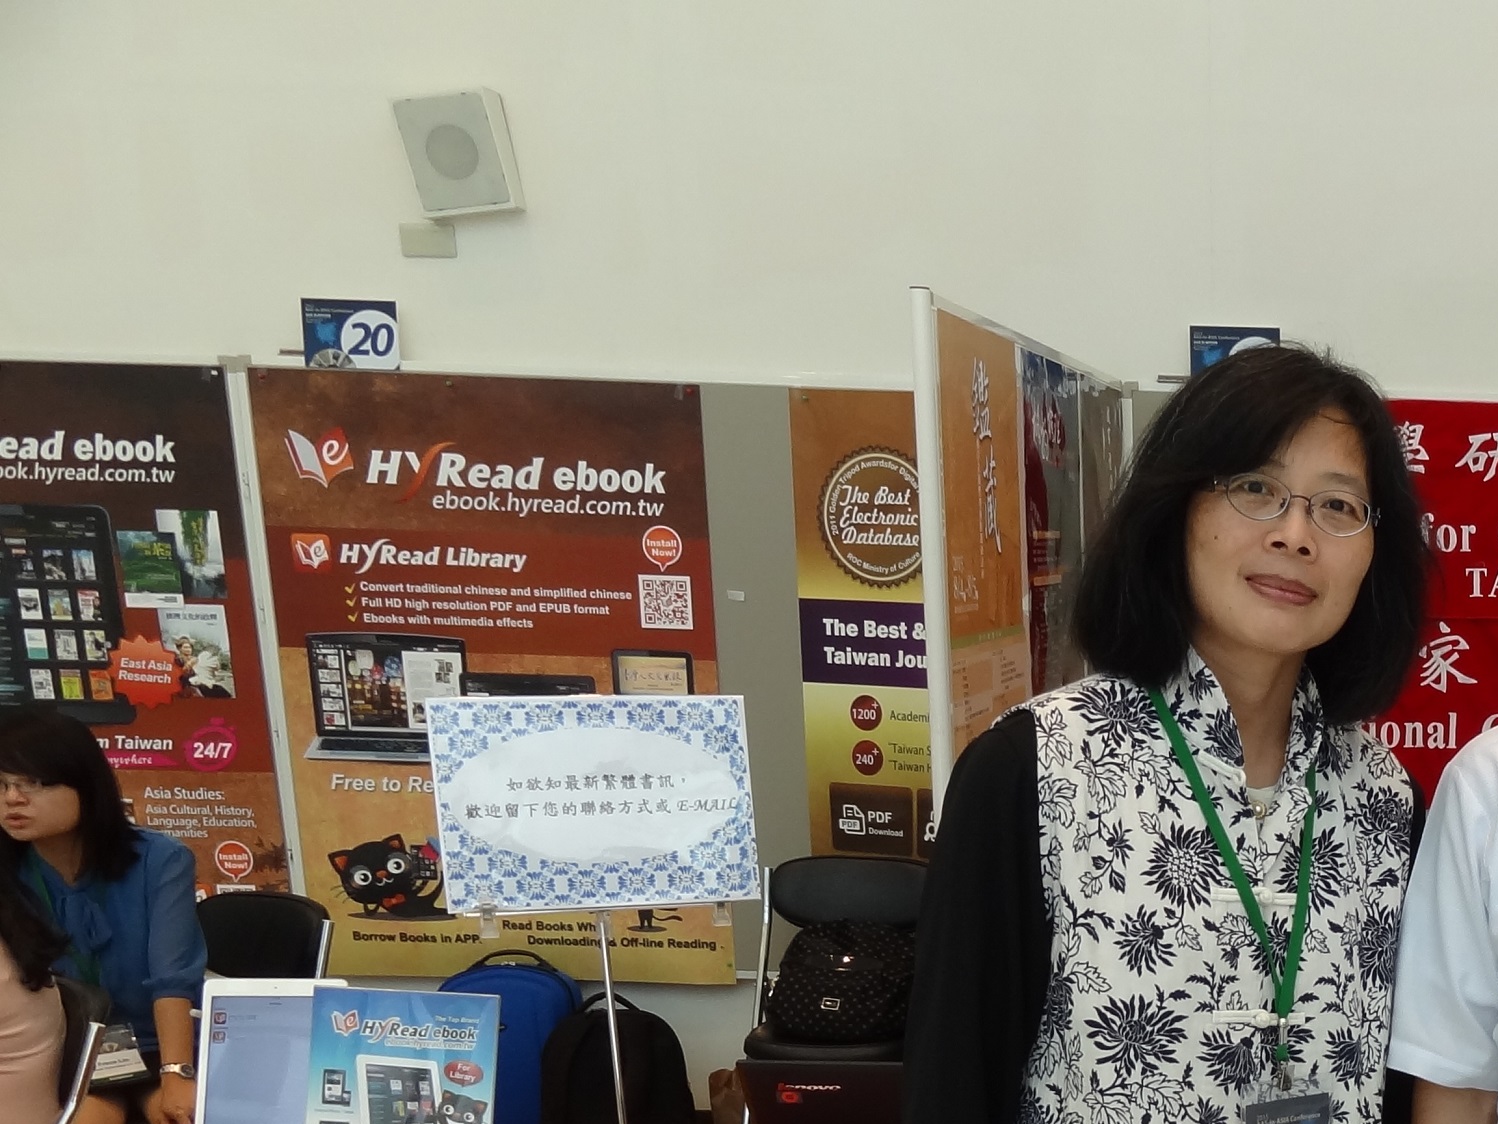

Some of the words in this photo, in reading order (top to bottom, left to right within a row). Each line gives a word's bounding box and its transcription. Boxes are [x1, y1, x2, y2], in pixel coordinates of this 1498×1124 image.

[347, 322, 395, 357] 20
[0, 430, 65, 461] ead
[73, 432, 176, 463] ebook
[0, 462, 175, 485] ok.hyread.com.tw
[553, 461, 666, 494] ebook
[840, 485, 869, 506] The
[874, 486, 911, 505] Best
[432, 490, 664, 518] ebook.hyread.com.tw
[840, 506, 919, 528] Electronic
[646, 538, 677, 549] Install
[842, 526, 919, 547] Database
[446, 546, 527, 573] Library
[651, 548, 677, 558] Now!
[863, 562, 889, 574] Ministry
[360, 581, 403, 593] Convert
[405, 582, 462, 595] traditional
[465, 584, 507, 597] chinese
[510, 586, 531, 598] and
[533, 586, 586, 601] simplified
[589, 588, 632, 601] chinese
[361, 597, 382, 609] Full
[385, 598, 402, 609] HD
[404, 598, 428, 612] high
[432, 600, 487, 612] resolution
[490, 601, 513, 612] PDF
[516, 602, 536, 613] and
[539, 602, 570, 614] EPUB
[573, 603, 610, 616] format
[363, 613, 404, 626] Ebooks
[407, 614, 431, 626] with
[434, 615, 494, 628] multimedia
[496, 617, 533, 629] effects
[823, 618, 858, 637] The
[863, 619, 907, 640] Best
[912, 622, 926, 640] &
[120, 657, 147, 669] East
[148, 658, 173, 672] Asia
[824, 646, 891, 667] Taiwan
[895, 650, 928, 669] Jou
[118, 670, 172, 684] Research
[889, 709, 930, 722] Academi
[1368, 712, 1457, 749] ional
[115, 735, 173, 750] Taiwan
[193, 742, 232, 759] 24/7
[108, 755, 152, 768] nywhere
[331, 772, 376, 791] Free
[382, 774, 400, 792] to
[408, 775, 433, 793] Re
[144, 786, 172, 799] Asia
[174, 787, 225, 801] Studies:
[145, 804, 168, 816] Asia
[169, 804, 213, 817] Cultural,
[214, 805, 255, 818] History,
[867, 811, 893, 823] PDF
[147, 815, 200, 829] Language,
[203, 816, 257, 829] Education,
[160, 828, 208, 839] manities
[868, 827, 904, 838] Download
[218, 852, 248, 861] Install
[503, 920, 533, 931] Read
[536, 920, 573, 932] Books
[352, 931, 396, 943] Borrow
[400, 932, 437, 944] Books
[440, 932, 452, 944] in
[527, 935, 600, 949] Downloading
[620, 937, 664, 950] Off-line
[667, 938, 716, 952] Reading
[433, 1025, 478, 1041] ebook
